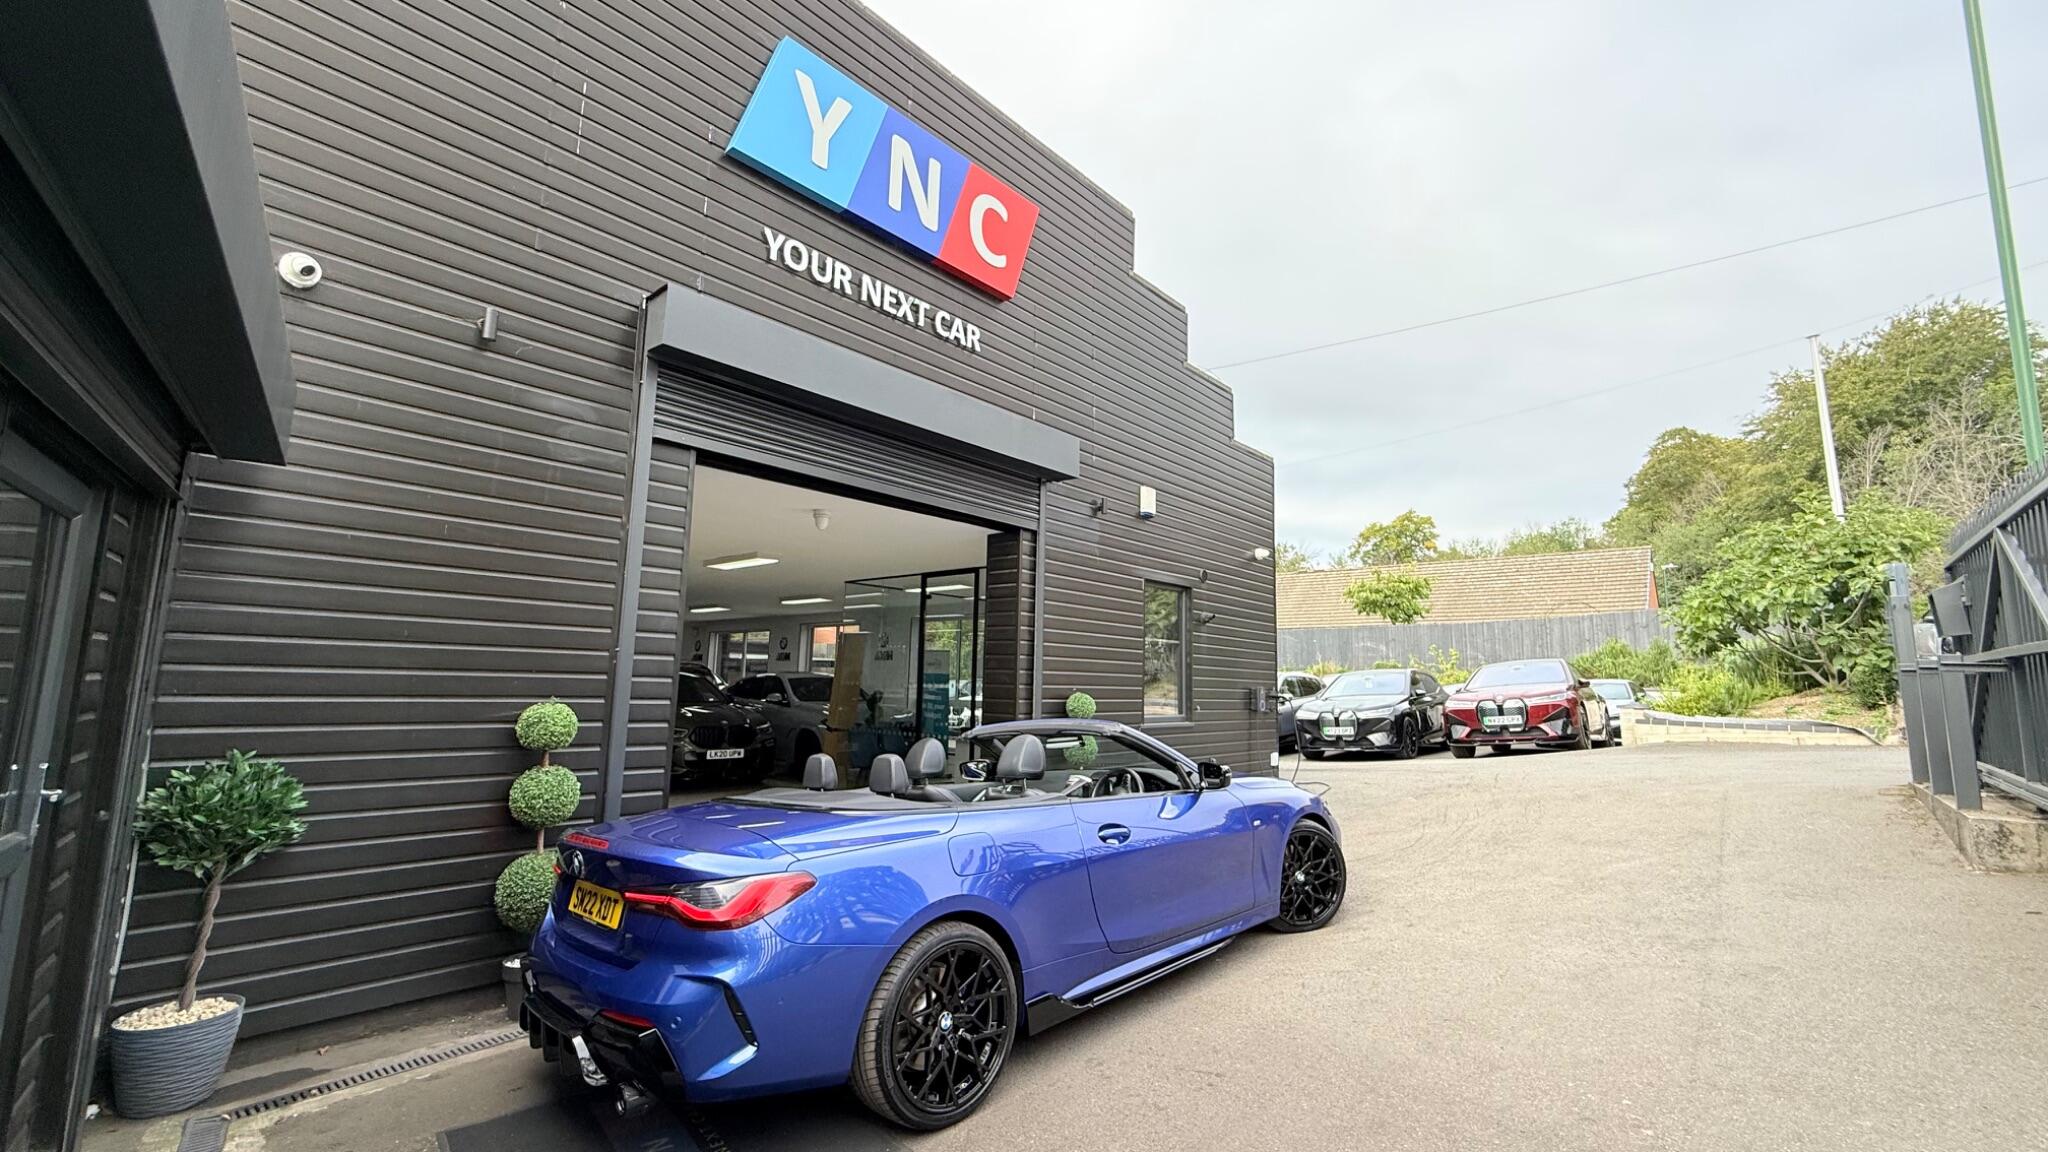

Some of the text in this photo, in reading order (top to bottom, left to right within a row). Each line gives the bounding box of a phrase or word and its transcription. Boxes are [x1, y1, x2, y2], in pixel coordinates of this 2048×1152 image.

[795, 69, 1009, 269] YNC
[763, 227, 982, 352] YOUR NEXT CAR
[595, 894, 620, 924] XDT
